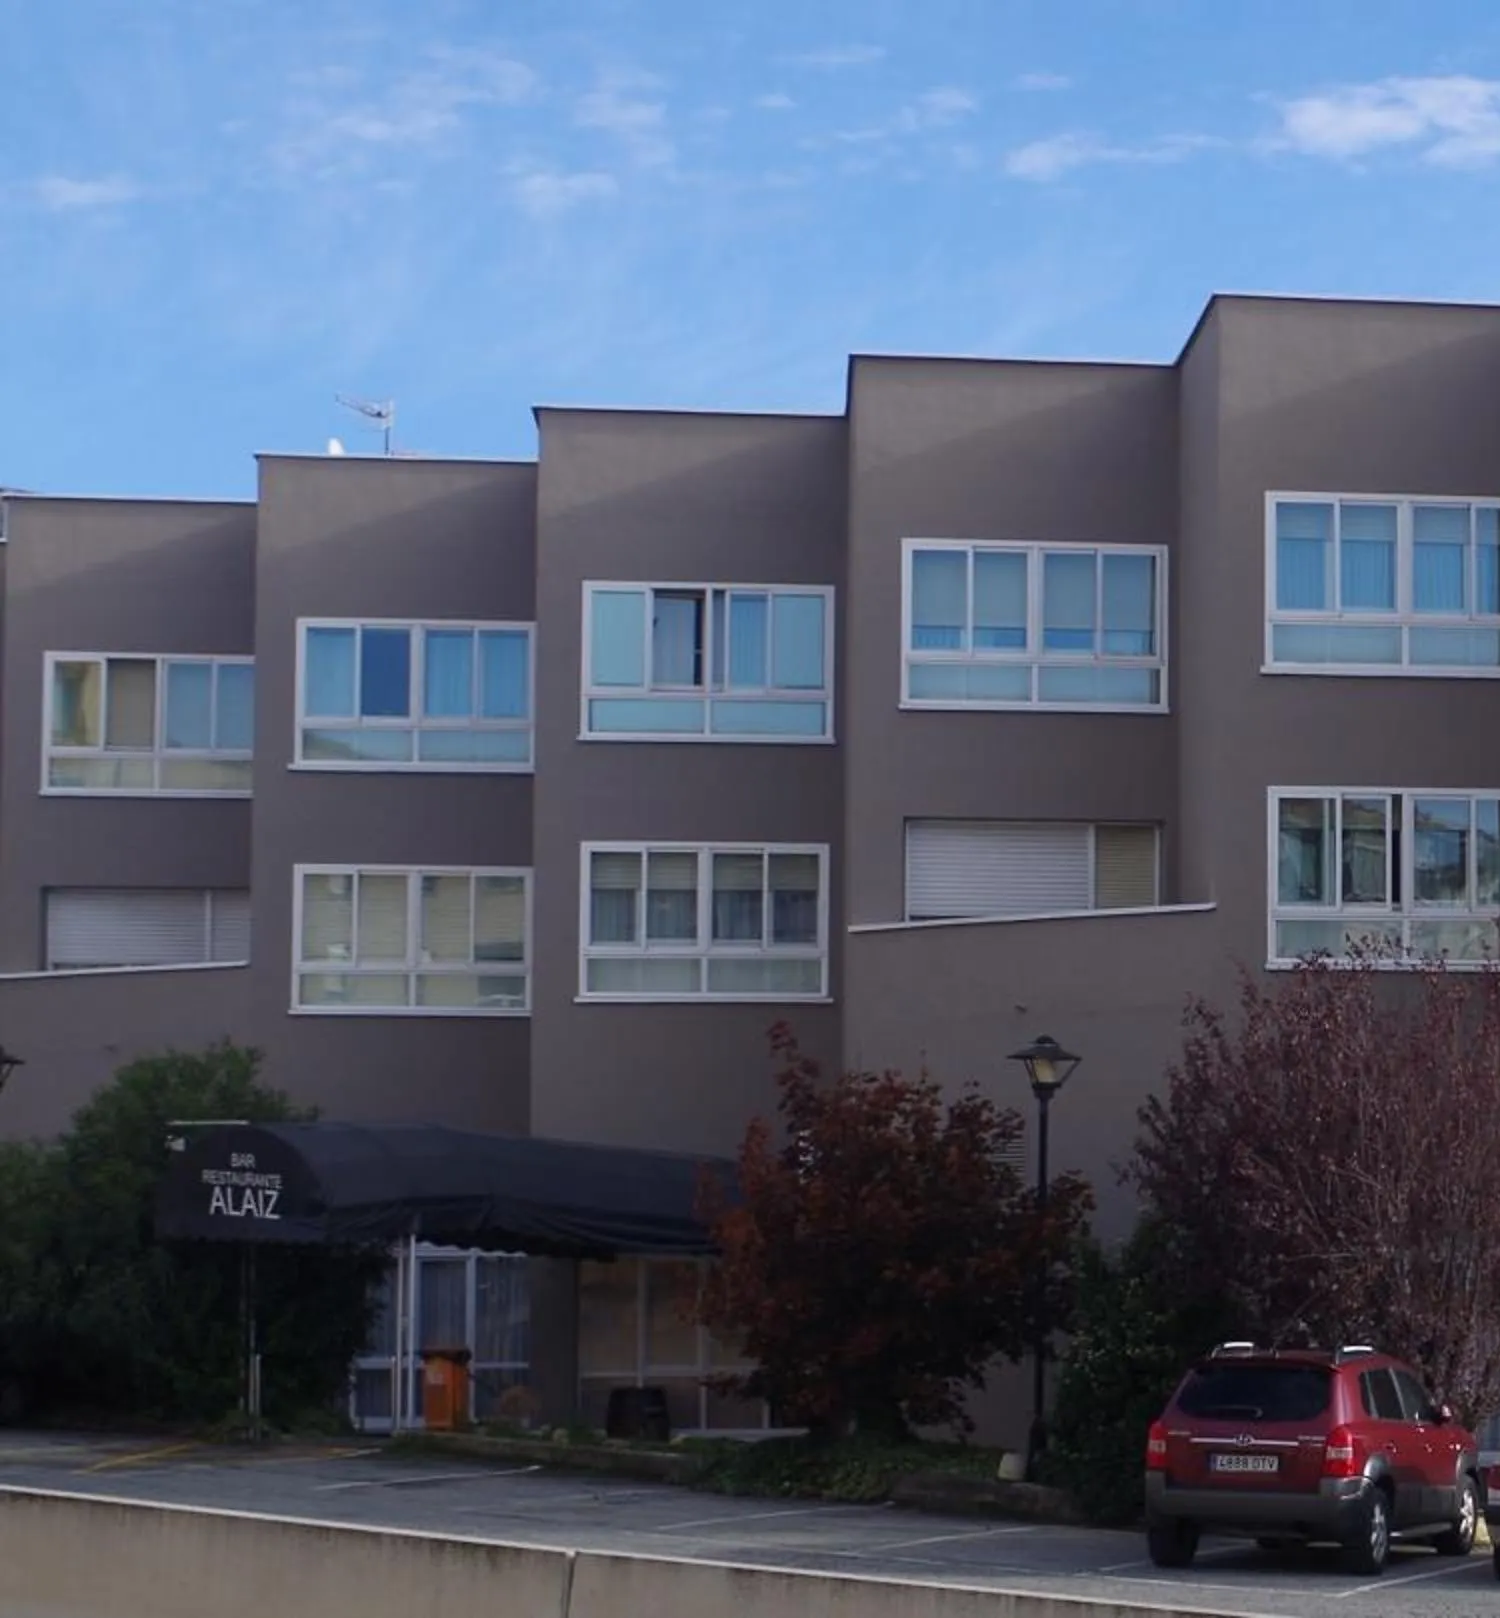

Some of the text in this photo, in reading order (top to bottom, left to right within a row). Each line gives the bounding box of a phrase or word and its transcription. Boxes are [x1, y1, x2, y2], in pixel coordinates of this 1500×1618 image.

[231, 1153, 256, 1168] BAR
[202, 1169, 282, 1189] RESTAURANTE
[209, 1185, 281, 1220] ALAIZ
